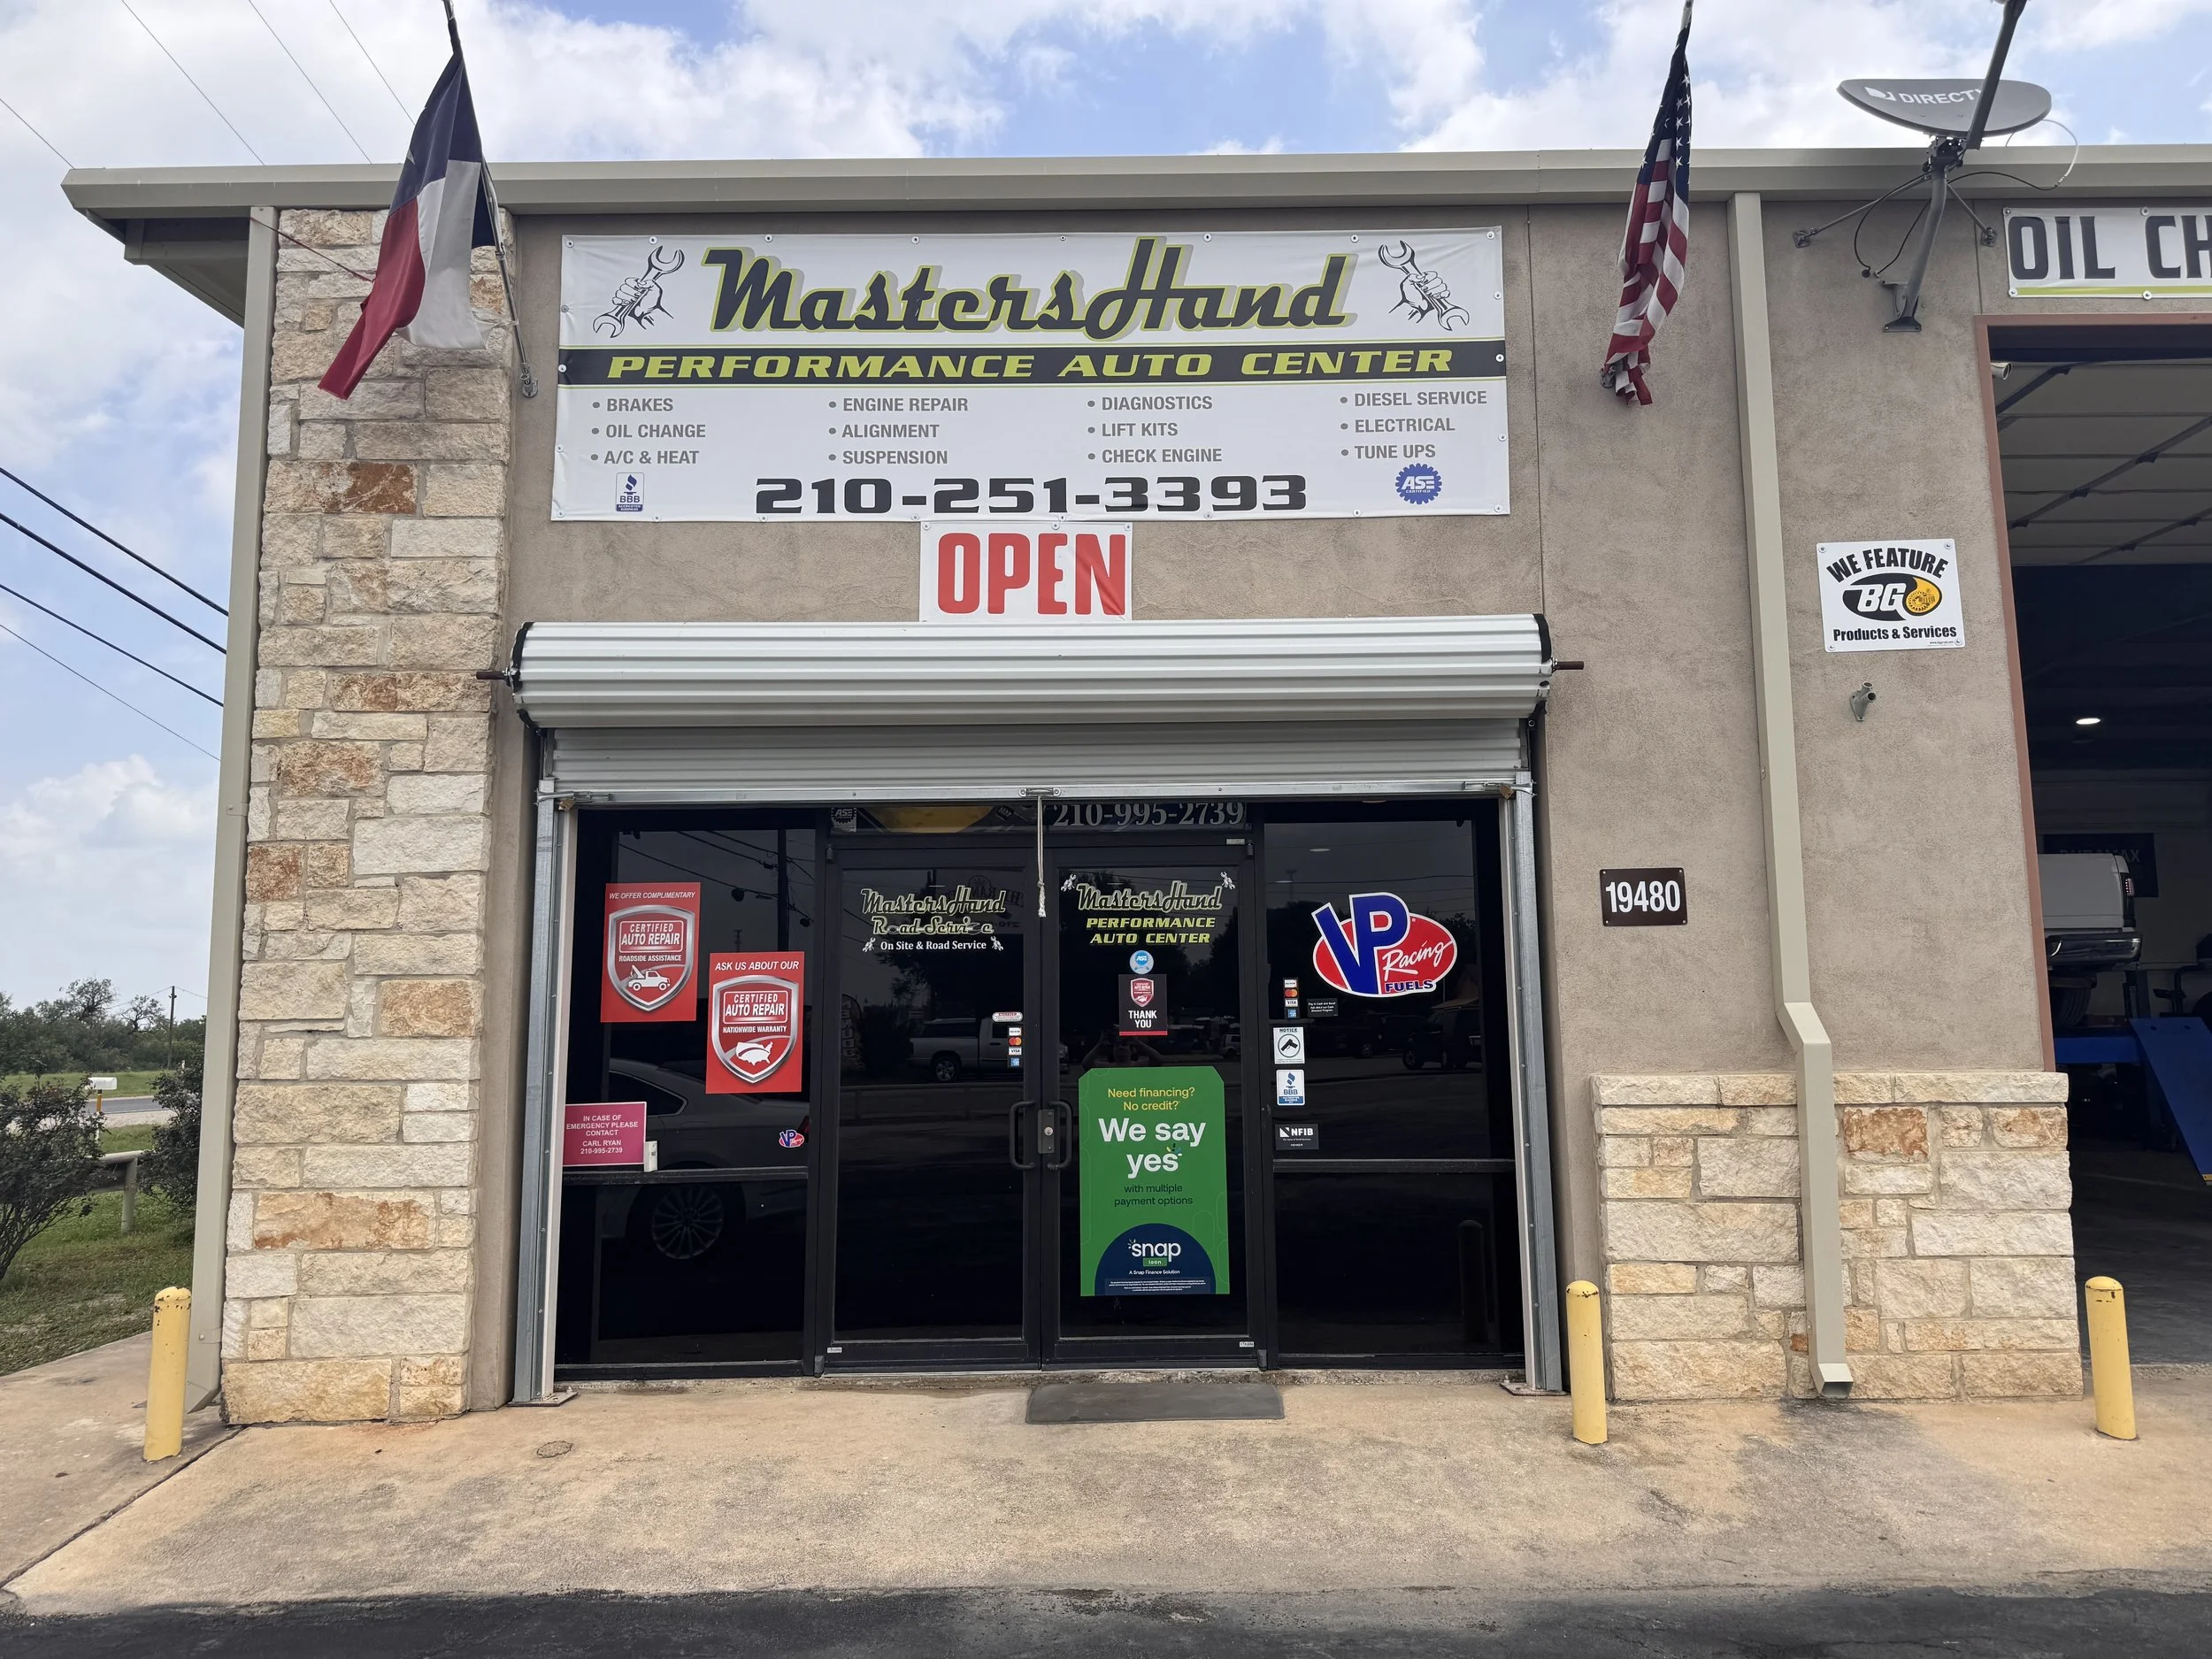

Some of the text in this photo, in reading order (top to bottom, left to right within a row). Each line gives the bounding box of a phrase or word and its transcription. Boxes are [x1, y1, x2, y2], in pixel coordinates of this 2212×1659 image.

[2008, 216, 2116, 280] OIL
[608, 349, 1453, 379] PERFORMANCE AUTO CENTER
[606, 397, 673, 412] BRAKES
[842, 397, 969, 412] ENGINE REPAIR
[1102, 396, 1213, 411] DIAGNOSTICS
[1354, 390, 1487, 407] DIESEL SERVICE
[605, 424, 706, 439] OIL CHANGE
[841, 424, 940, 439] ALIGNMENT
[1102, 421, 1179, 438] LIFT KITS
[1354, 418, 1455, 434] ELECTRICAL
[603, 449, 700, 465] A/C & HEAT
[842, 449, 949, 465] SUSPENSION
[1102, 447, 1223, 465] CHECK ENGINE
[1355, 443, 1436, 461] TUNE UPS
[1401, 475, 1435, 490] ASE
[755, 476, 1307, 515] 210-251-3393
[1825, 548, 1949, 584] WE FEATURE
[938, 533, 1126, 615] OPEN
[1855, 583, 1908, 612] BG
[1832, 625, 1957, 642] Products & Services
[1053, 803, 1244, 827] 210-995-2739
[1605, 880, 1681, 913] 19480
[629, 923, 674, 933] CERTIFIED
[1086, 917, 1217, 928] PERFORMANCE
[621, 933, 680, 946] AUTO REPAIR
[880, 941, 987, 950] On Site & Road Service
[1089, 933, 1210, 944] AUTO CENTER
[1311, 892, 1411, 996] VP
[715, 961, 800, 971] ASK US ABOUT OUR
[1382, 940, 1452, 981] Racing
[1385, 980, 1434, 993] FUELS
[733, 993, 779, 1003] CERTIFIED
[726, 1002, 786, 1017] AUTO REPAIR
[1128, 1010, 1157, 1019] THANK
[1134, 1018, 1152, 1028] YOU
[1108, 1087, 1195, 1099] Need financing?
[1123, 1102, 1139, 1110] No
[780, 1129, 796, 1147] VP
[1098, 1118, 1207, 1148] We say
[1291, 1127, 1314, 1136] NFIB
[1126, 1154, 1179, 1179] yes
[1124, 1184, 1183, 1194] with multiple
[1114, 1196, 1194, 1207] payment options
[1131, 1242, 1182, 1263] snap
